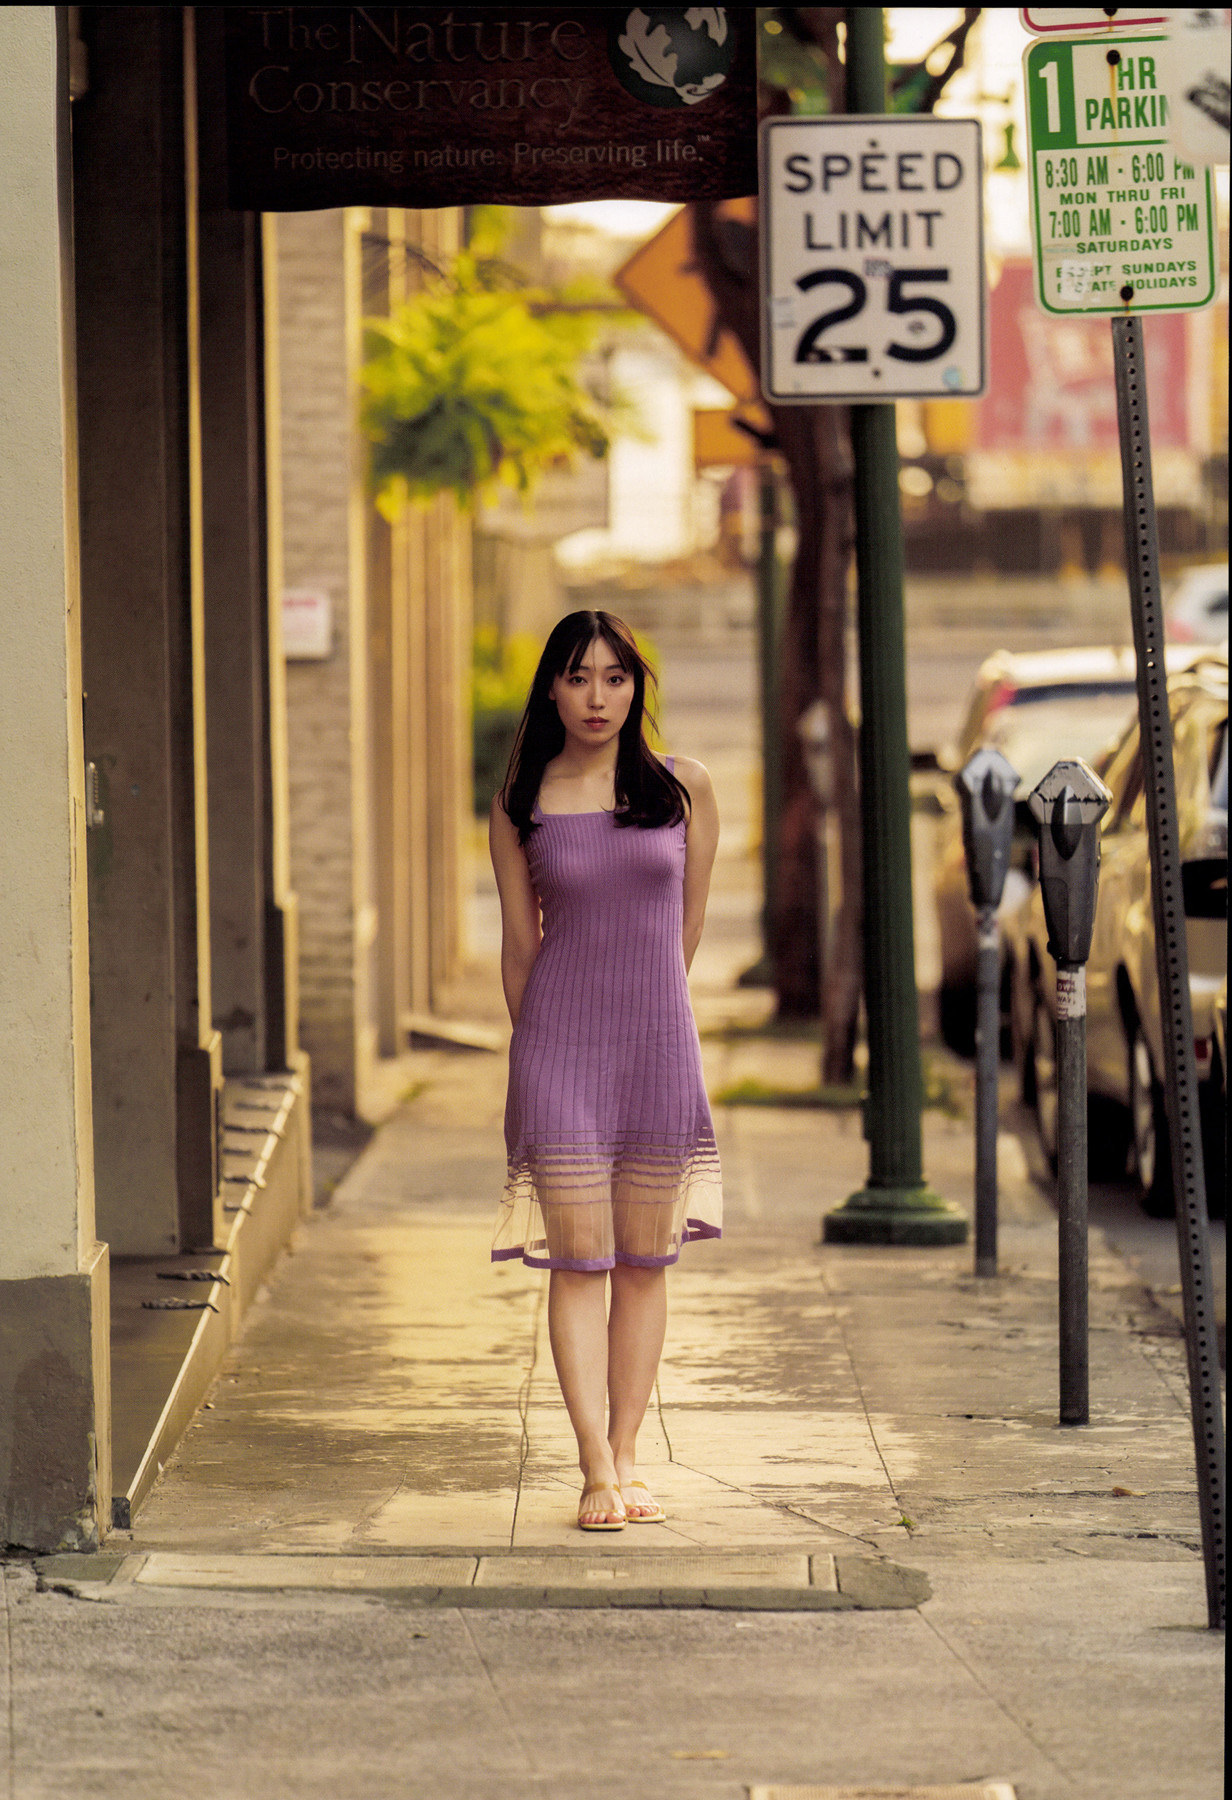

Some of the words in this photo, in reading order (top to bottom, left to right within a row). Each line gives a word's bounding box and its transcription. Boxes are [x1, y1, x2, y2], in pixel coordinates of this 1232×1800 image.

[248, 8, 338, 51] The
[347, 8, 589, 63] Nature
[1117, 56, 1158, 91] HR
[248, 65, 592, 129] Conservancy
[1038, 61, 1061, 133] 1
[1085, 95, 1170, 131] PARKIN
[273, 146, 403, 174] Protecting
[413, 143, 502, 167] nature.
[514, 140, 647, 168] Preserving
[785, 153, 964, 193] SPEED
[1045, 157, 1078, 188] 8:30
[1087, 155, 1109, 186] AM
[1132, 152, 1164, 183] 6:00
[1059, 192, 1097, 206] MON
[1107, 189, 1150, 203] THRU
[1161, 186, 1186, 200] FRI
[804, 210, 942, 251] LIMIT
[1049, 210, 1081, 238] 7:00
[1089, 208, 1112, 236] AM
[1135, 206, 1168, 235] 6:00
[1177, 203, 1199, 232] PM
[1076, 238, 1173, 254] SATURDAYS
[1122, 260, 1197, 275] SUNDAYS
[795, 268, 956, 364] 25
